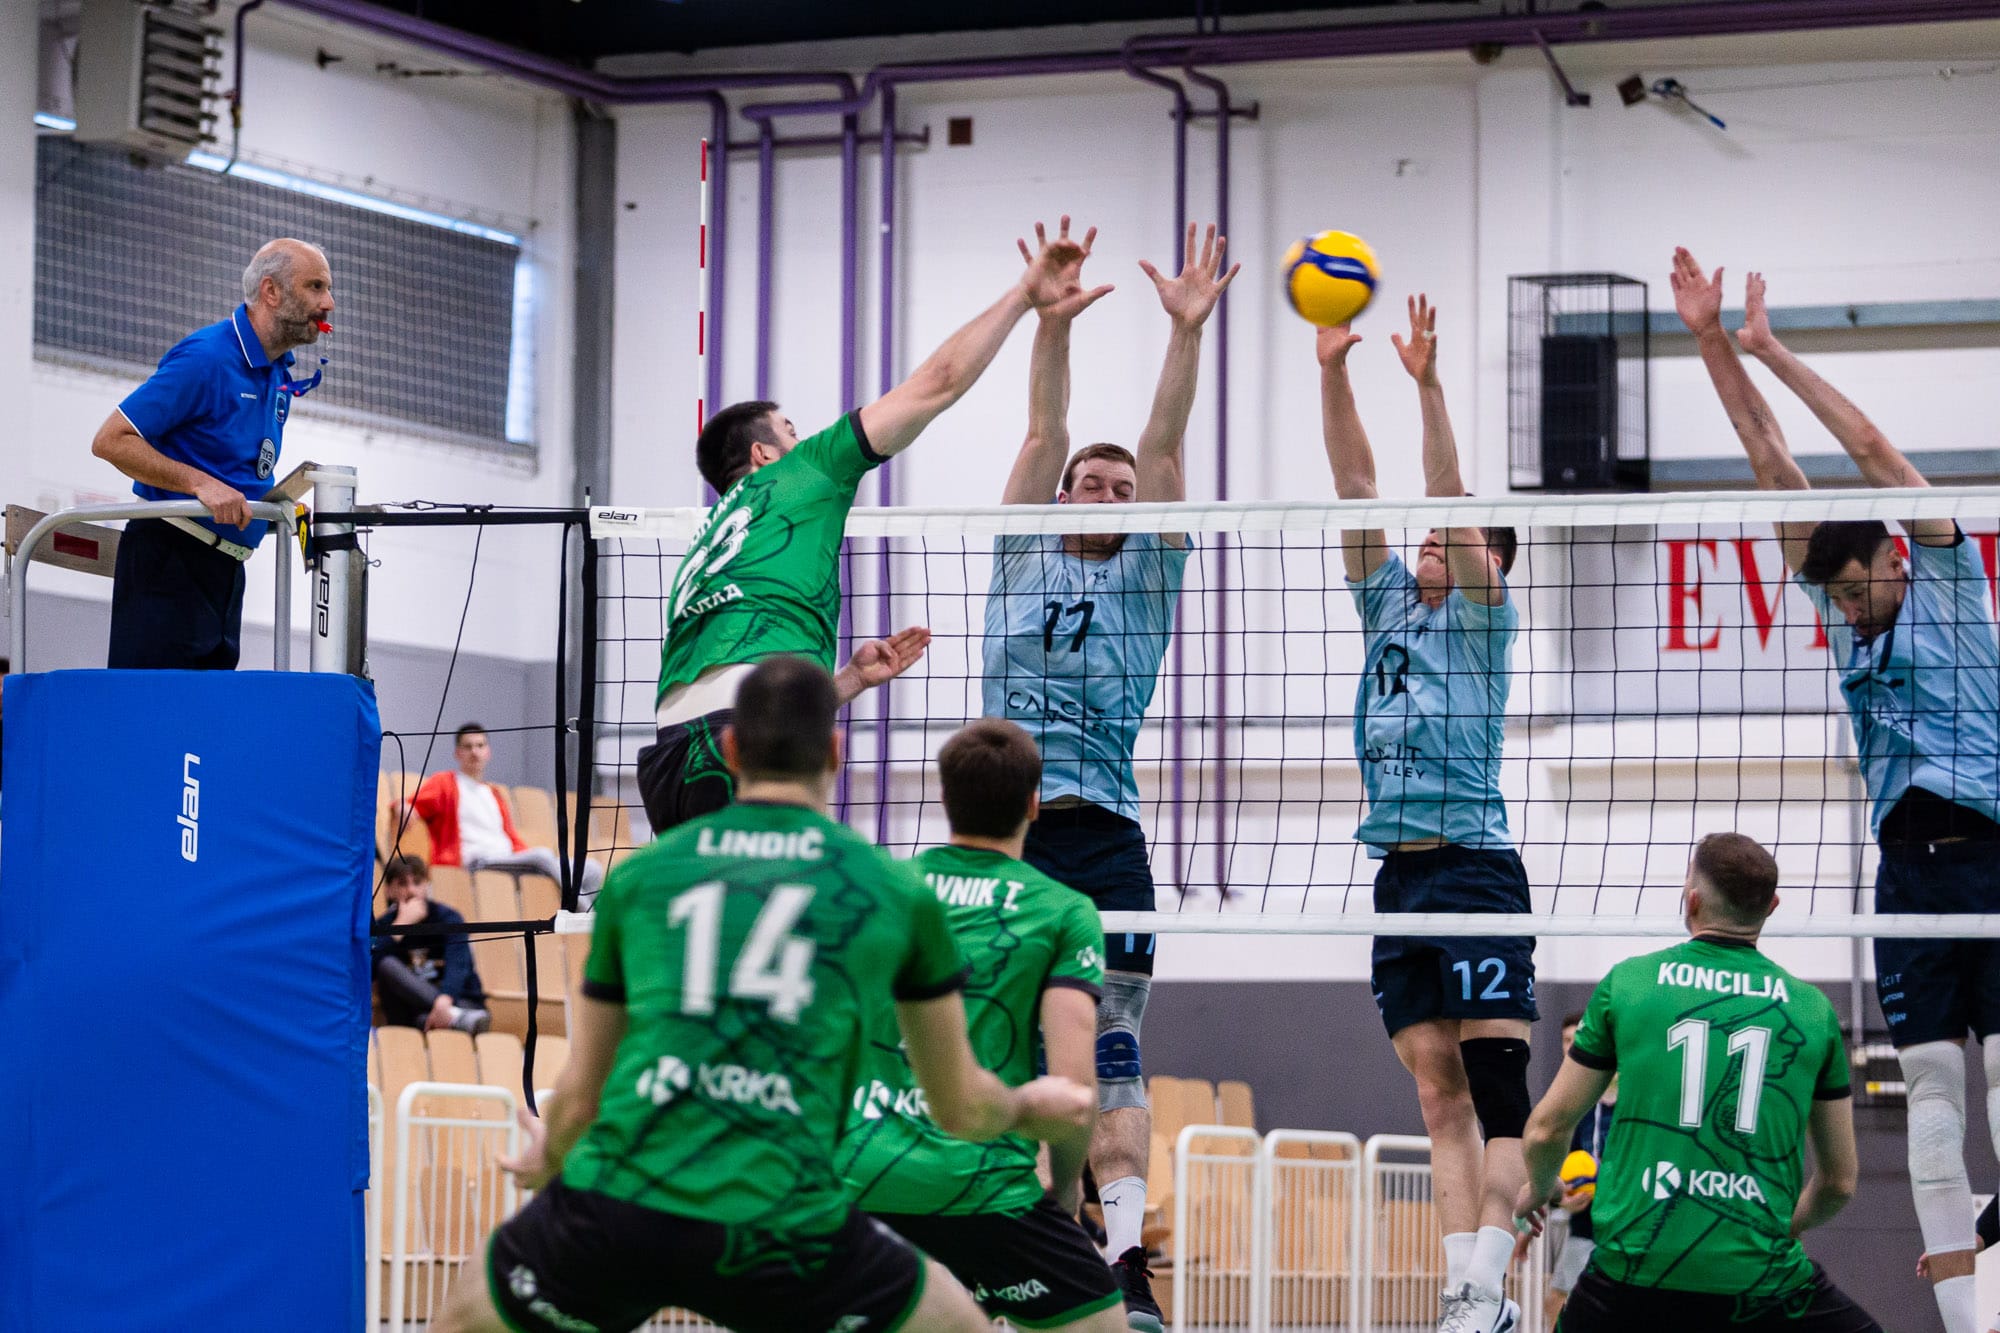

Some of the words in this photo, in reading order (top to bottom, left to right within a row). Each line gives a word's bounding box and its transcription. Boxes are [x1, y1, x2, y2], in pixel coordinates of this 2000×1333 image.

[598, 510, 638, 521] elan
[316, 551, 331, 638] elan
[1043, 600, 1095, 653] 17
[176, 752, 201, 863] elan
[696, 827, 825, 861] LINDIČ
[666, 880, 818, 1026] 14
[1452, 957, 1510, 1001] 12
[1657, 962, 1790, 1003] KONCILJA
[696, 1062, 802, 1116] KRKA
[1667, 1018, 1772, 1134] 11
[1688, 1169, 1767, 1204] KRKA
[992, 1279, 1050, 1301] KRKA
